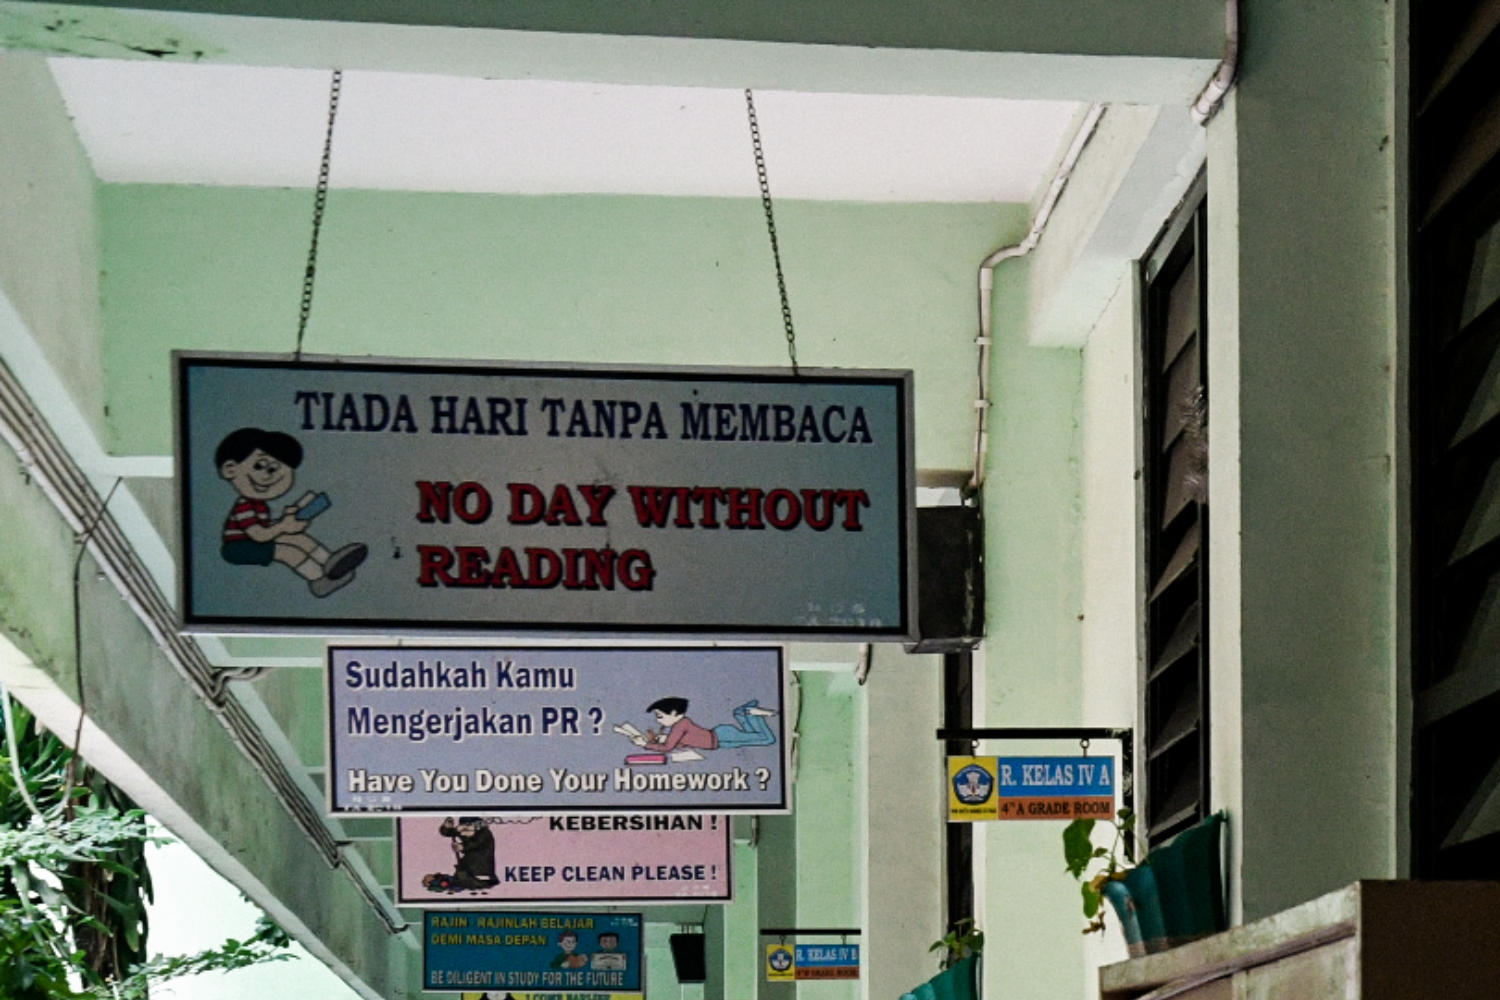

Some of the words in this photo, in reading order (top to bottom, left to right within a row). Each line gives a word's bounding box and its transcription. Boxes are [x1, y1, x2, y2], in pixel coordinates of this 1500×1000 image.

[295, 391, 417, 434] TIADA
[431, 396, 527, 437] HARI
[541, 398, 668, 440] TANPA
[682, 401, 873, 444] MEMBACA
[415, 480, 493, 526] NO
[508, 482, 618, 528] DAY
[627, 484, 871, 532] WITHOUT
[417, 544, 657, 591] READING
[345, 660, 487, 690] Sudahkah
[495, 661, 575, 690] Kamu
[347, 706, 533, 741] Mengerjakan
[541, 707, 580, 735] PR
[587, 705, 604, 735] ?
[347, 769, 414, 793] Have
[419, 769, 470, 793] You
[475, 769, 542, 793] Done
[548, 769, 608, 793] Your
[613, 767, 749, 792] Homework
[754, 767, 771, 791] ?
[1022, 764, 1074, 786] KELAS
[1078, 764, 1095, 786] IV
[1099, 764, 1111, 786] A
[1029, 802, 1071, 815] GRADE
[1074, 801, 1111, 814] ROOM
[550, 814, 703, 831] KEBERSIHAN
[504, 865, 556, 883] KEEP
[562, 865, 625, 883] CLEAN
[631, 864, 706, 881] PLEASE
[431, 916, 468, 928] RAJIN
[540, 917, 594, 930] BELAJAR
[431, 933, 463, 945] DEMI
[466, 934, 501, 946] MASA
[505, 934, 547, 946] DEPAN
[431, 970, 443, 984] BE
[447, 971, 493, 985] DILIGENT
[508, 971, 540, 986] STUDY
[542, 972, 562, 986] FOR
[565, 972, 583, 986] THE
[586, 972, 624, 987] FUTURE
